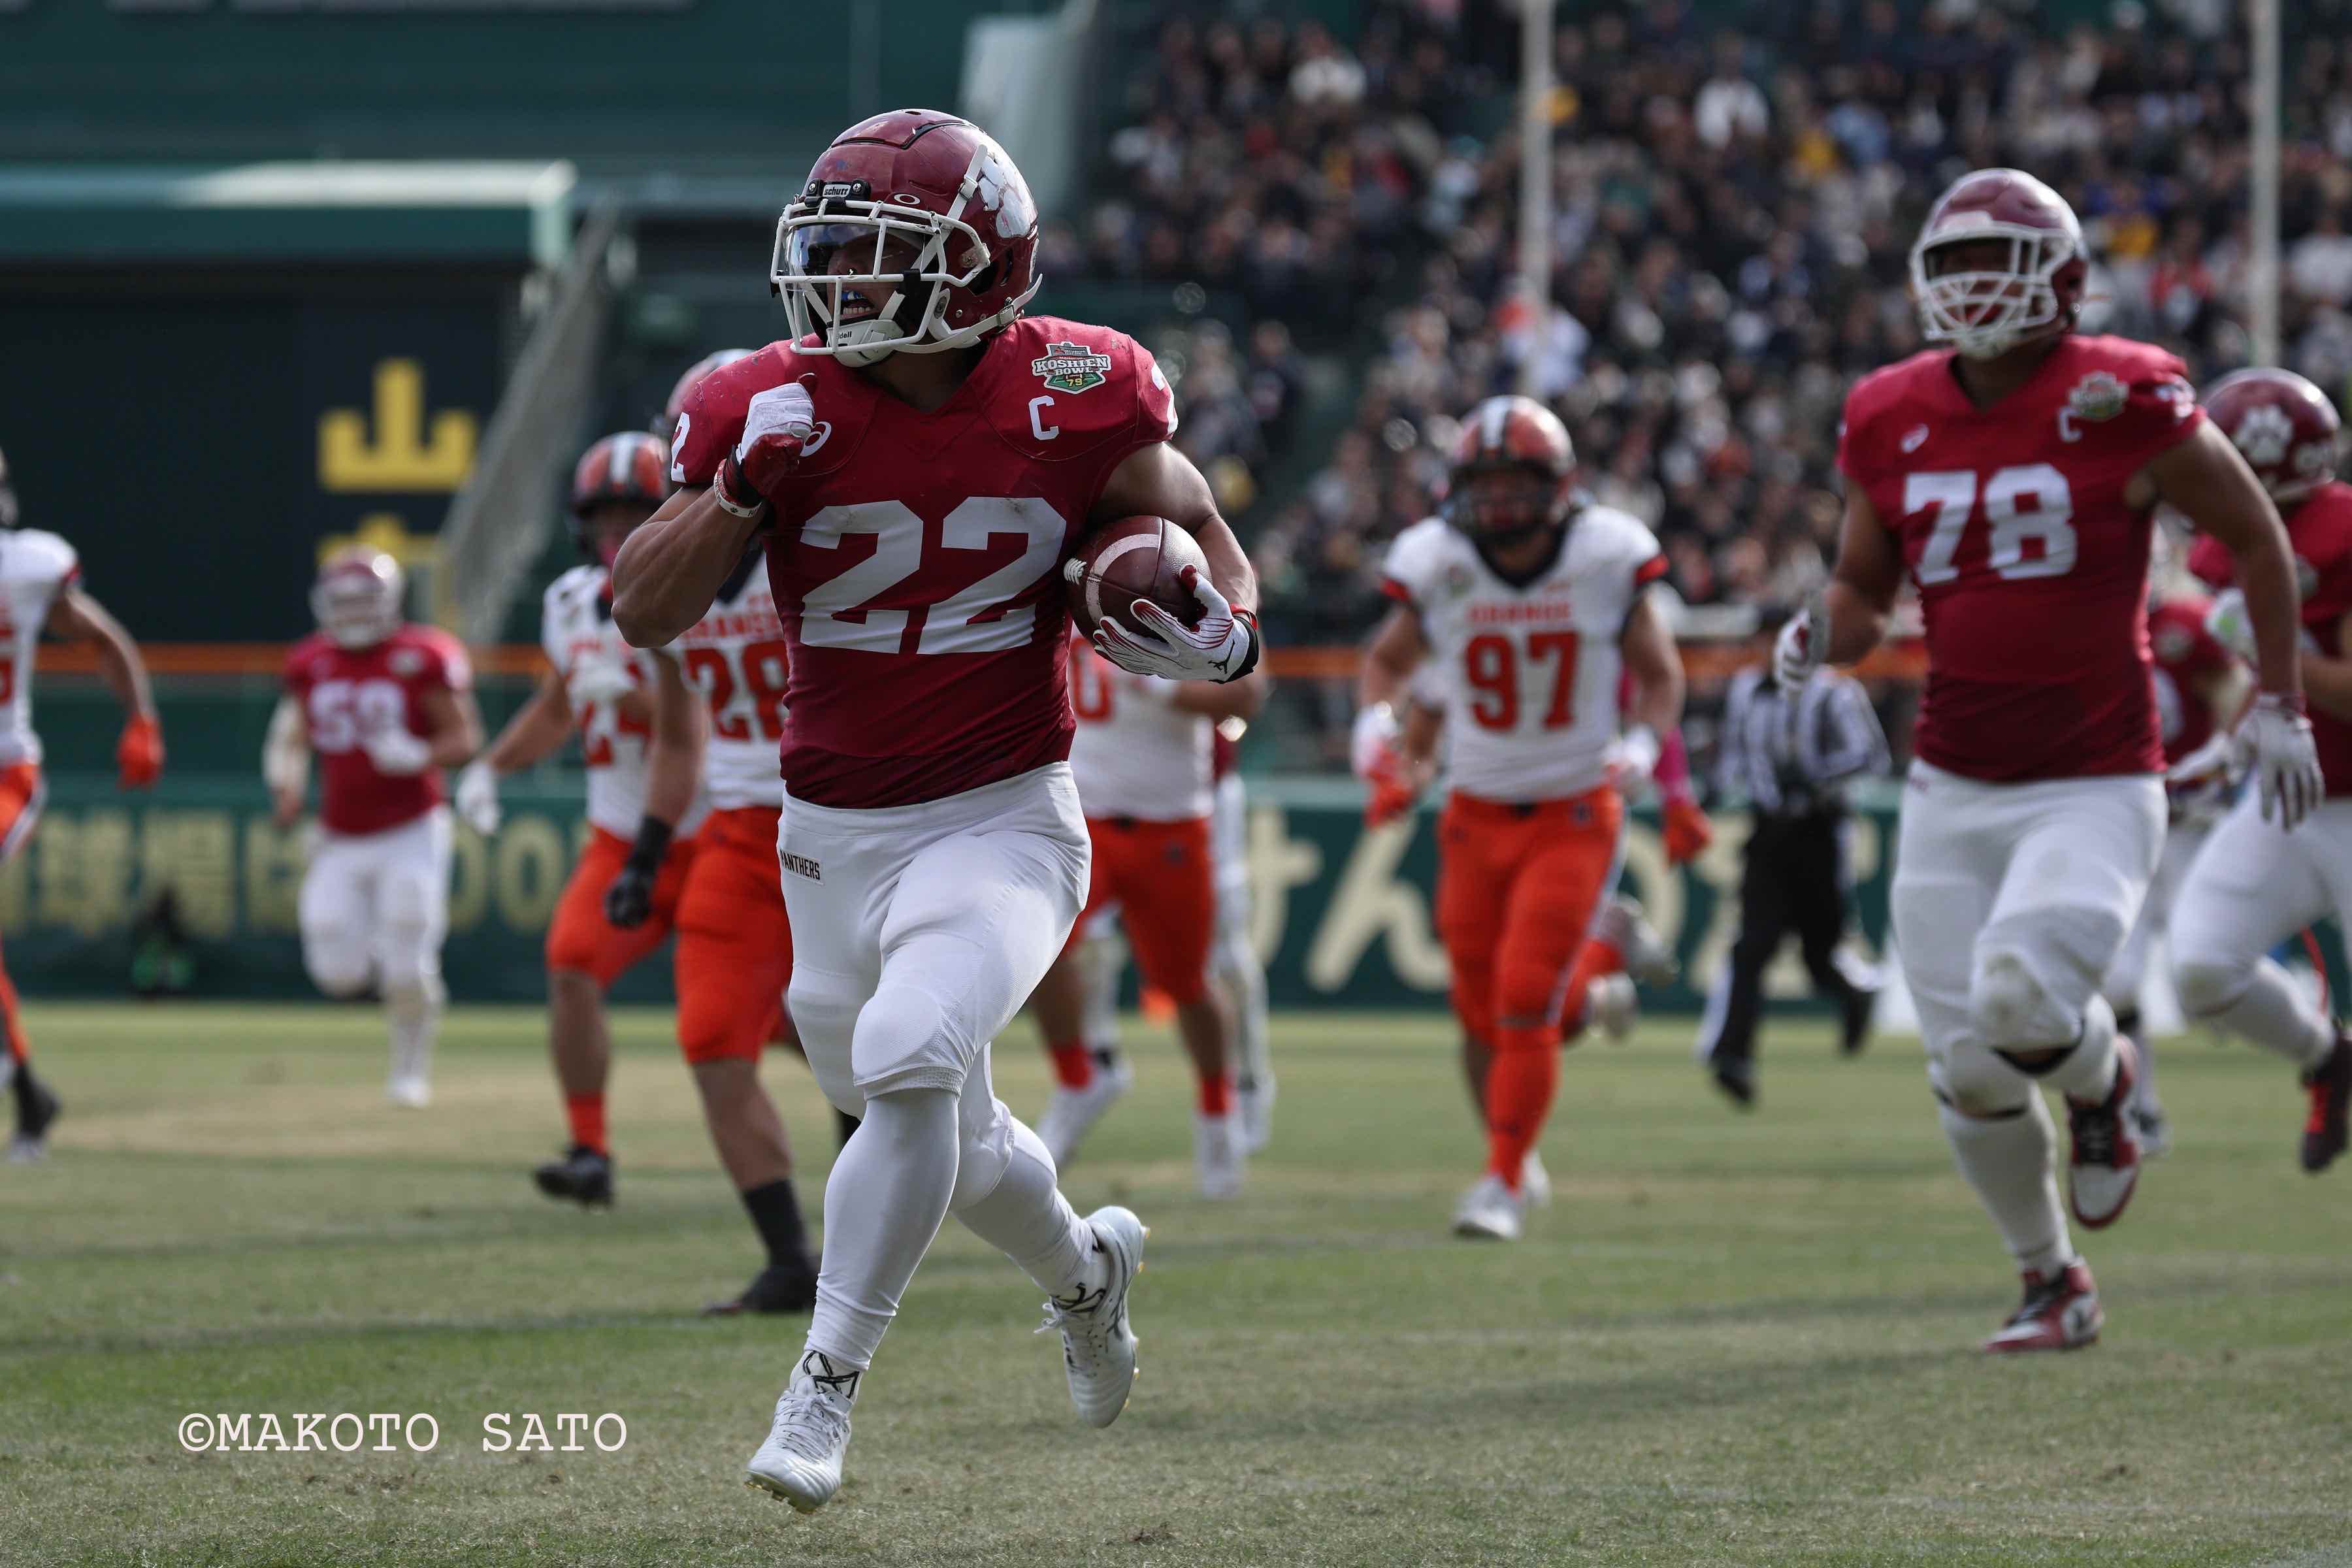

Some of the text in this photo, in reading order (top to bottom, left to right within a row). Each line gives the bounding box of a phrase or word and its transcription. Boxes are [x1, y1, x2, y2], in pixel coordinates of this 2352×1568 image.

[824, 187, 849, 196] schutt
[837, 331, 853, 340] dell
[1034, 357, 1108, 373] KOSHIEN
[1055, 367, 1093, 376] BOWL
[1066, 378, 1083, 387] 79
[1028, 395, 1059, 440] C
[1903, 463, 2078, 585] 78
[800, 497, 1067, 655] 22
[1465, 631, 1581, 732] 97
[779, 849, 821, 881] PANTHERS
